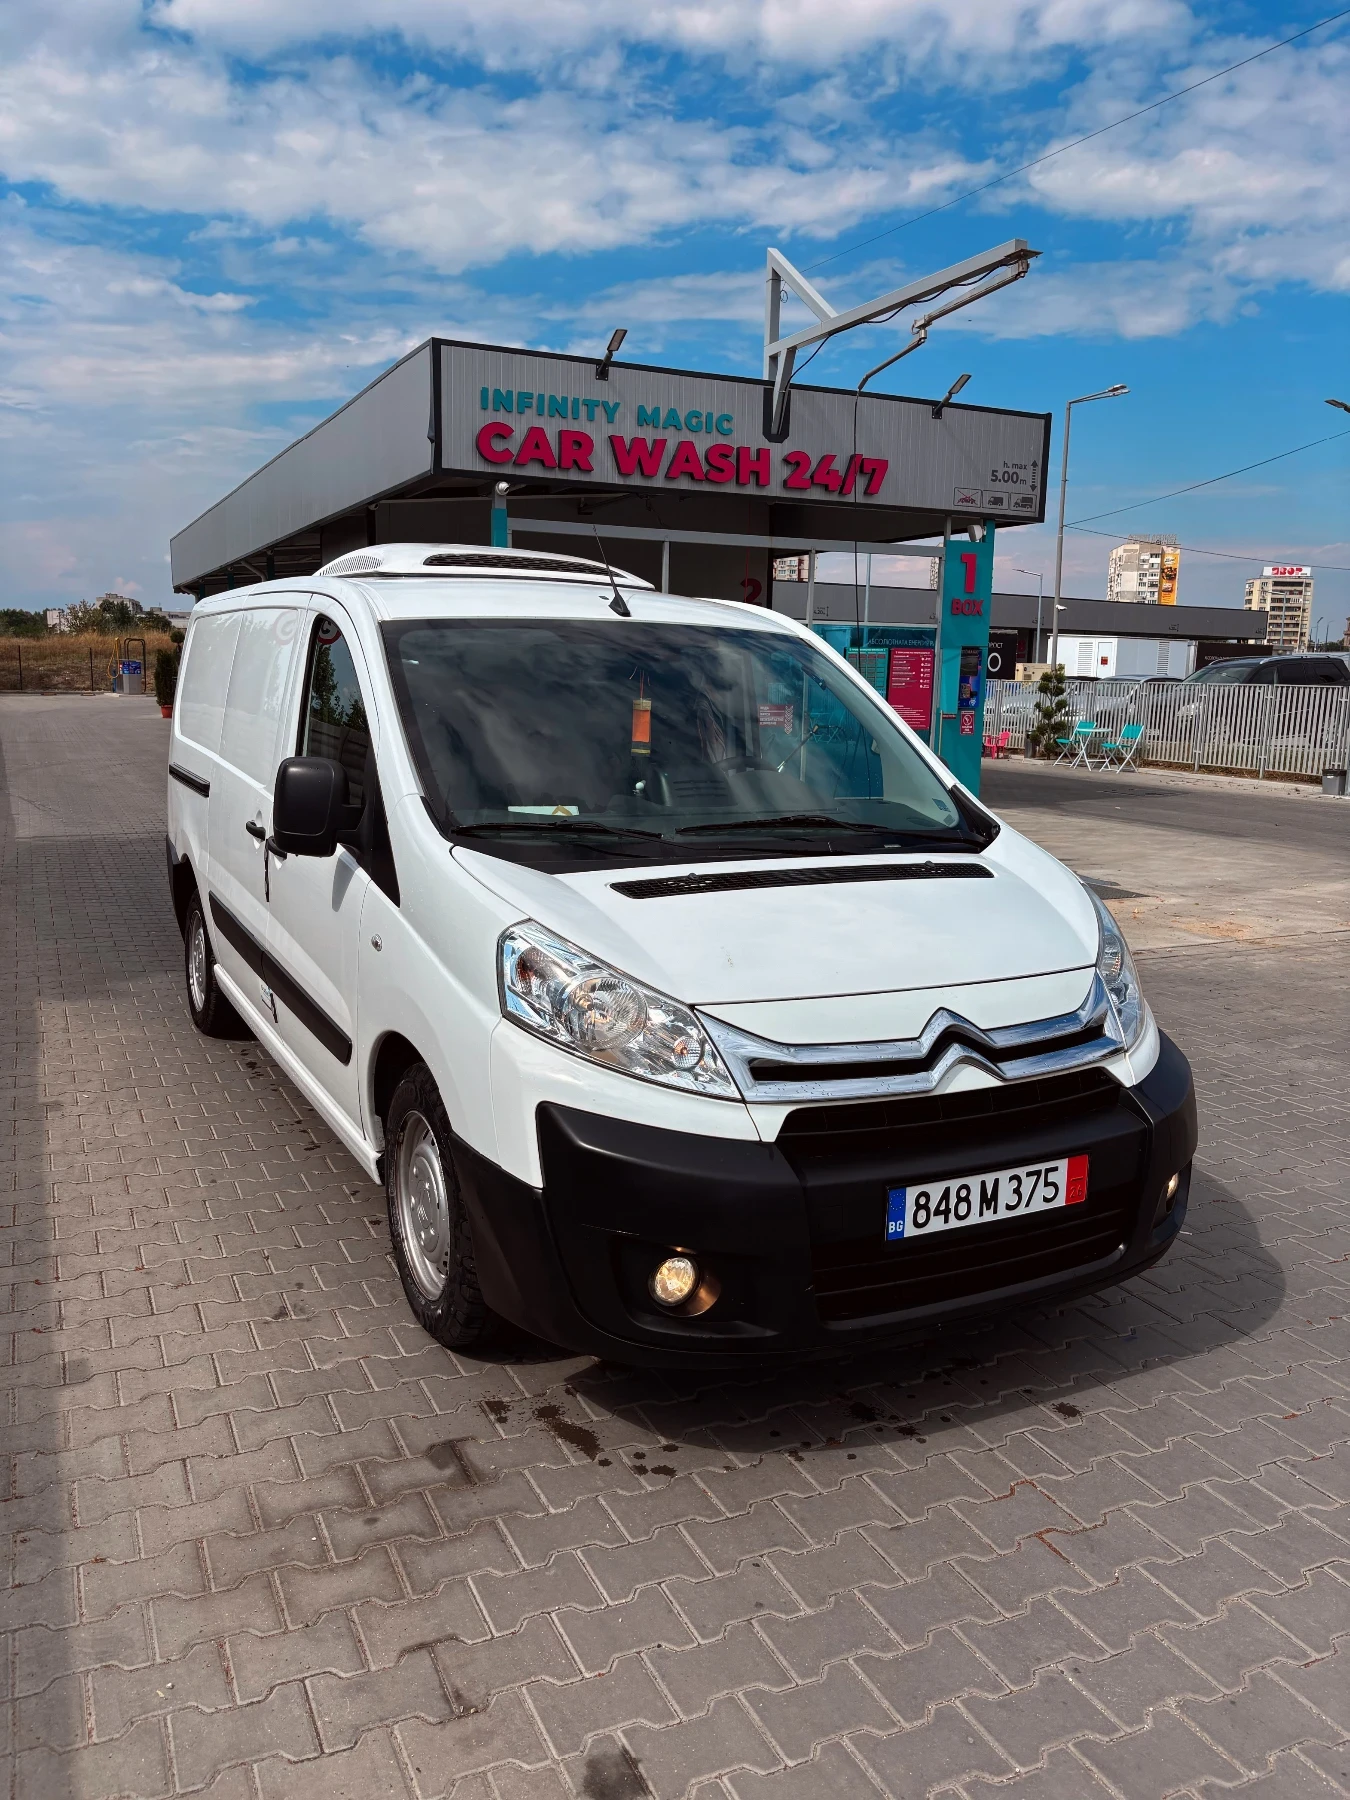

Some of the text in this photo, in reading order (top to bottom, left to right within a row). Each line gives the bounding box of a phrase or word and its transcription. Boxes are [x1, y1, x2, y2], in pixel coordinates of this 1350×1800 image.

[480, 386, 734, 435] INFINITY MAGIC
[476, 421, 889, 496] CAR WASH 24/7
[960, 552, 977, 594] 1
[951, 598, 984, 616] BOX
[888, 1220, 904, 1234] BG
